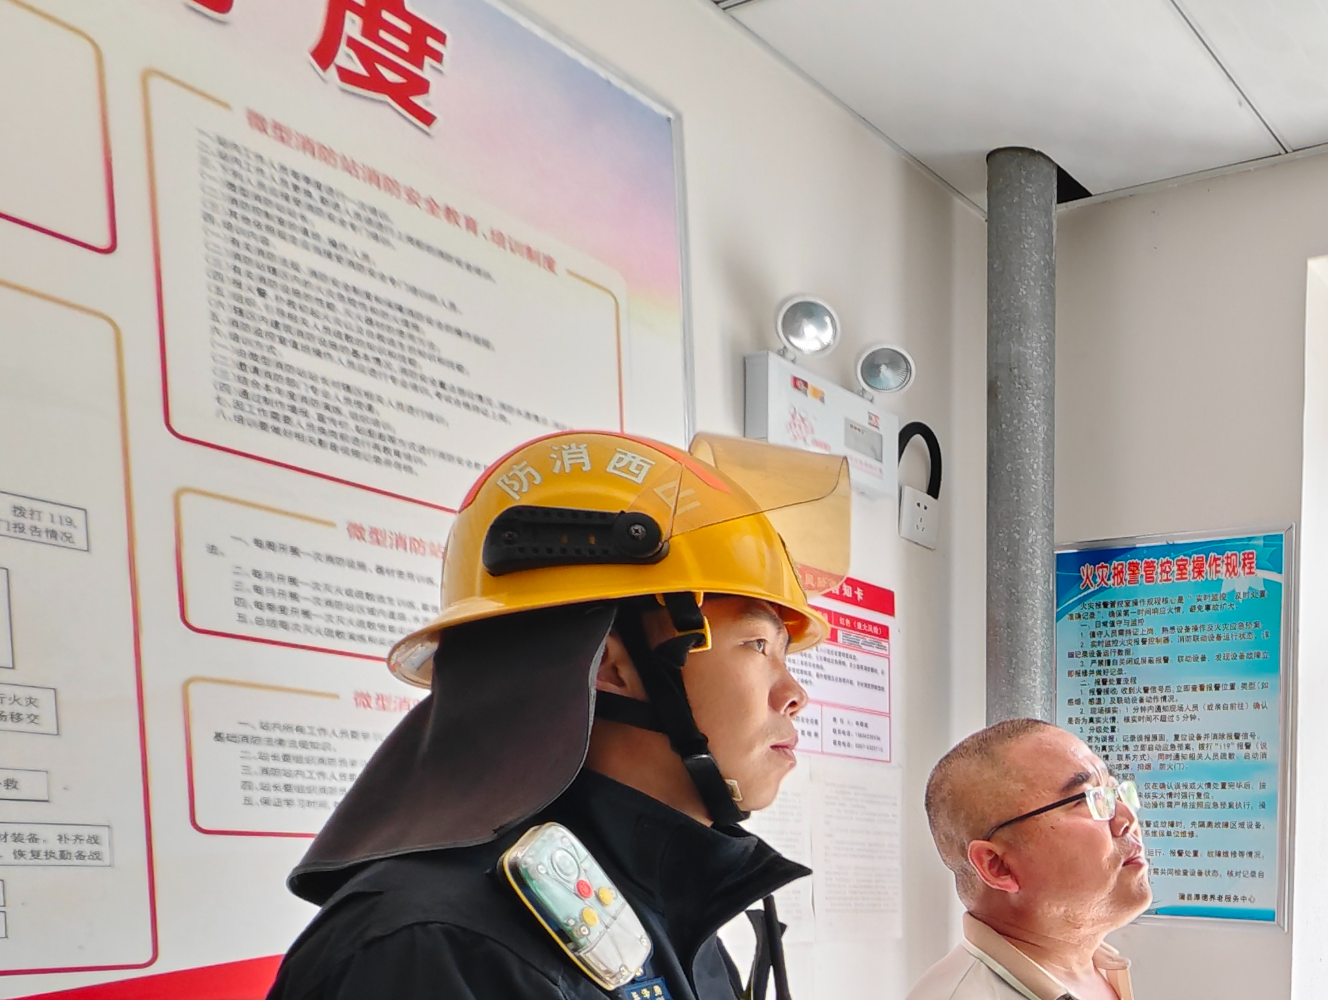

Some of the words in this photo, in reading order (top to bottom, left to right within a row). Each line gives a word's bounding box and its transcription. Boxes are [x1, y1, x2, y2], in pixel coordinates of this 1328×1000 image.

[183, 0, 447, 128] 度
[246, 108, 558, 276] 微型消防站消防安全教育、培训制度
[1079, 548, 1256, 589] 火灾报警管控室操作规程
